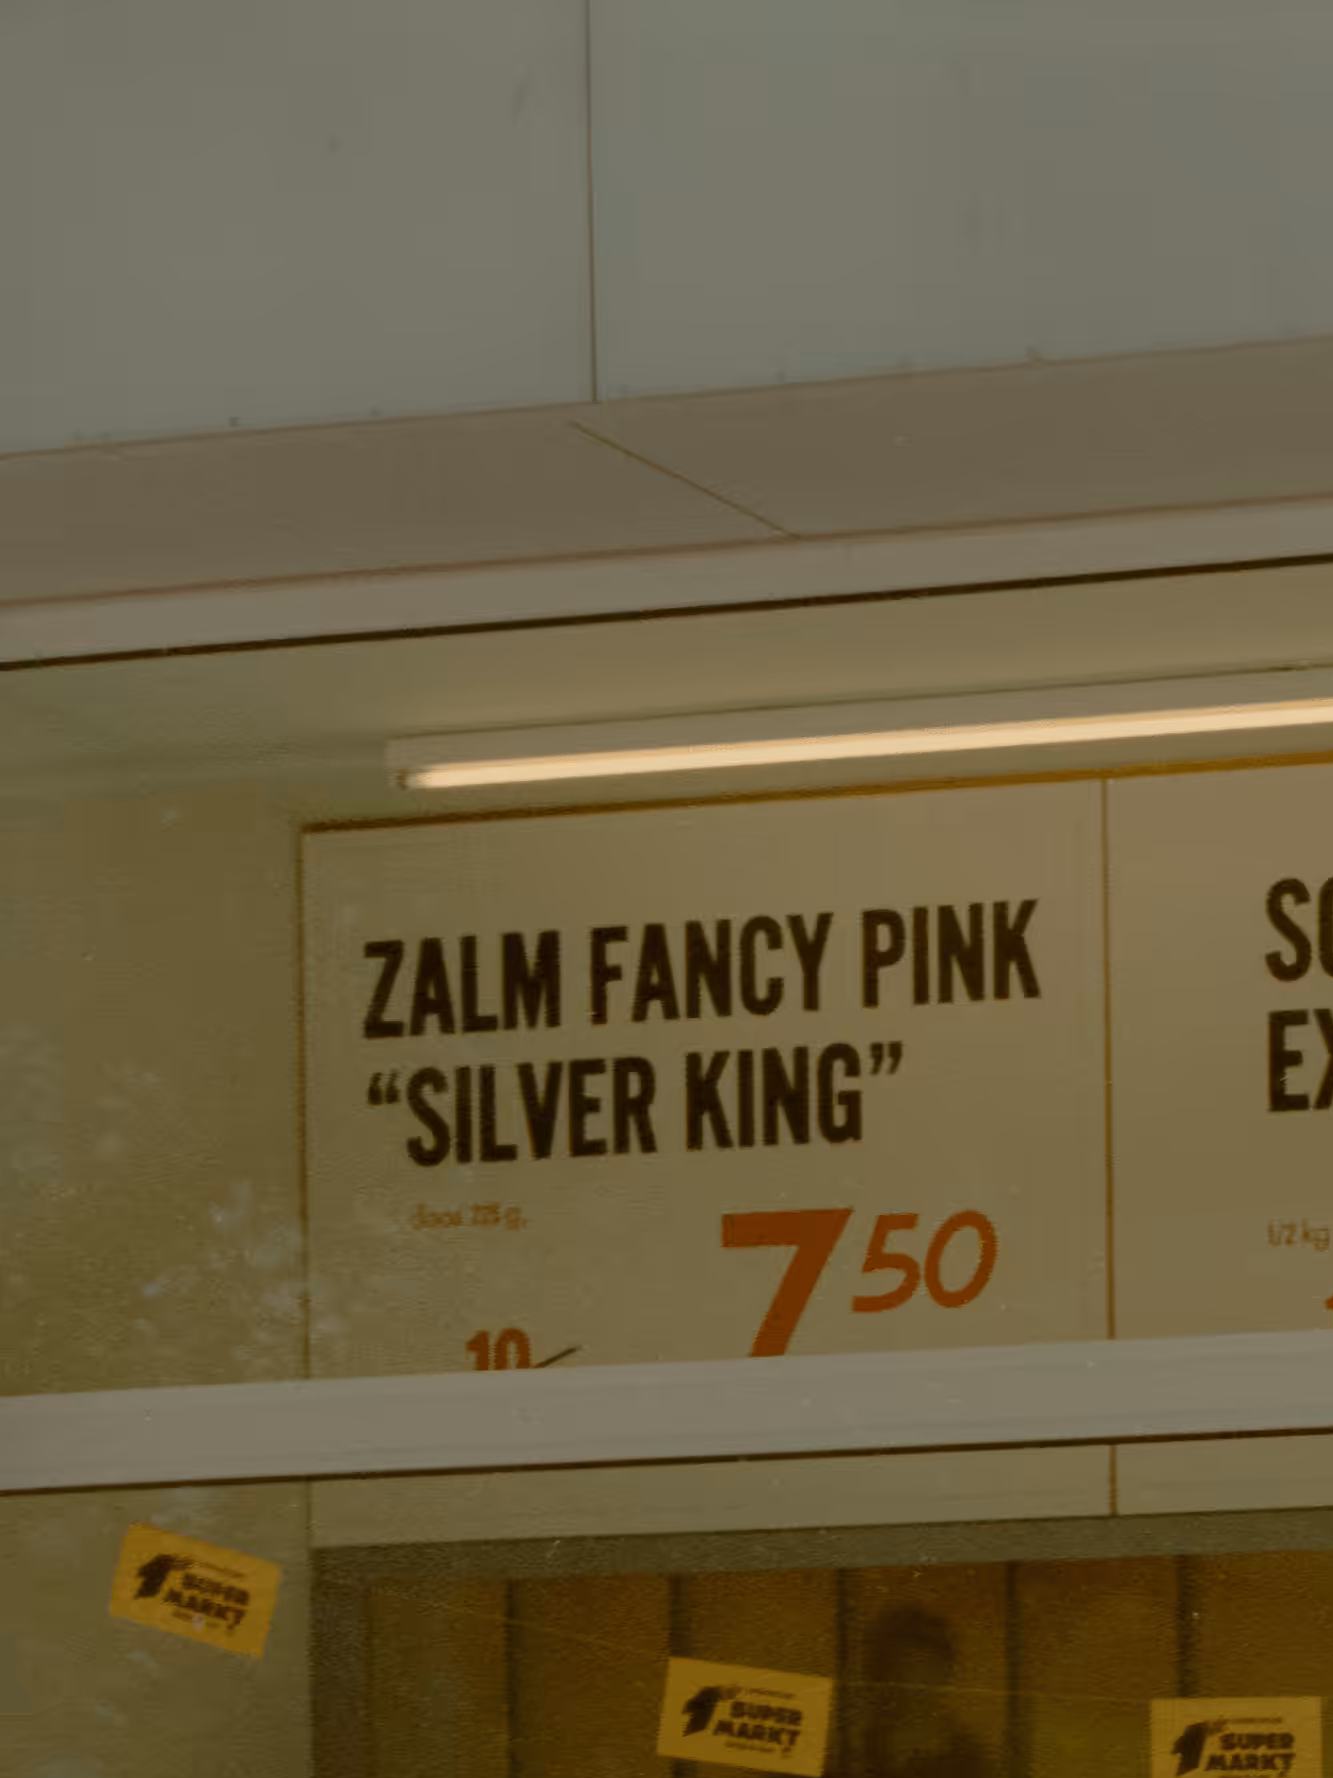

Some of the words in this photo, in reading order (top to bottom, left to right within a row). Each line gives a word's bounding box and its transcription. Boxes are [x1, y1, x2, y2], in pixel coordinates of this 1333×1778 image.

[364, 930, 560, 1038] ZALM
[591, 912, 833, 1025] FANCY
[860, 898, 1041, 1008] PINK
[367, 1057, 657, 1166] “SILVER
[685, 1042, 903, 1151] KING”
[1205, 1752, 1296, 1773] MARKT
[1219, 1733, 1295, 1751] SUPER
